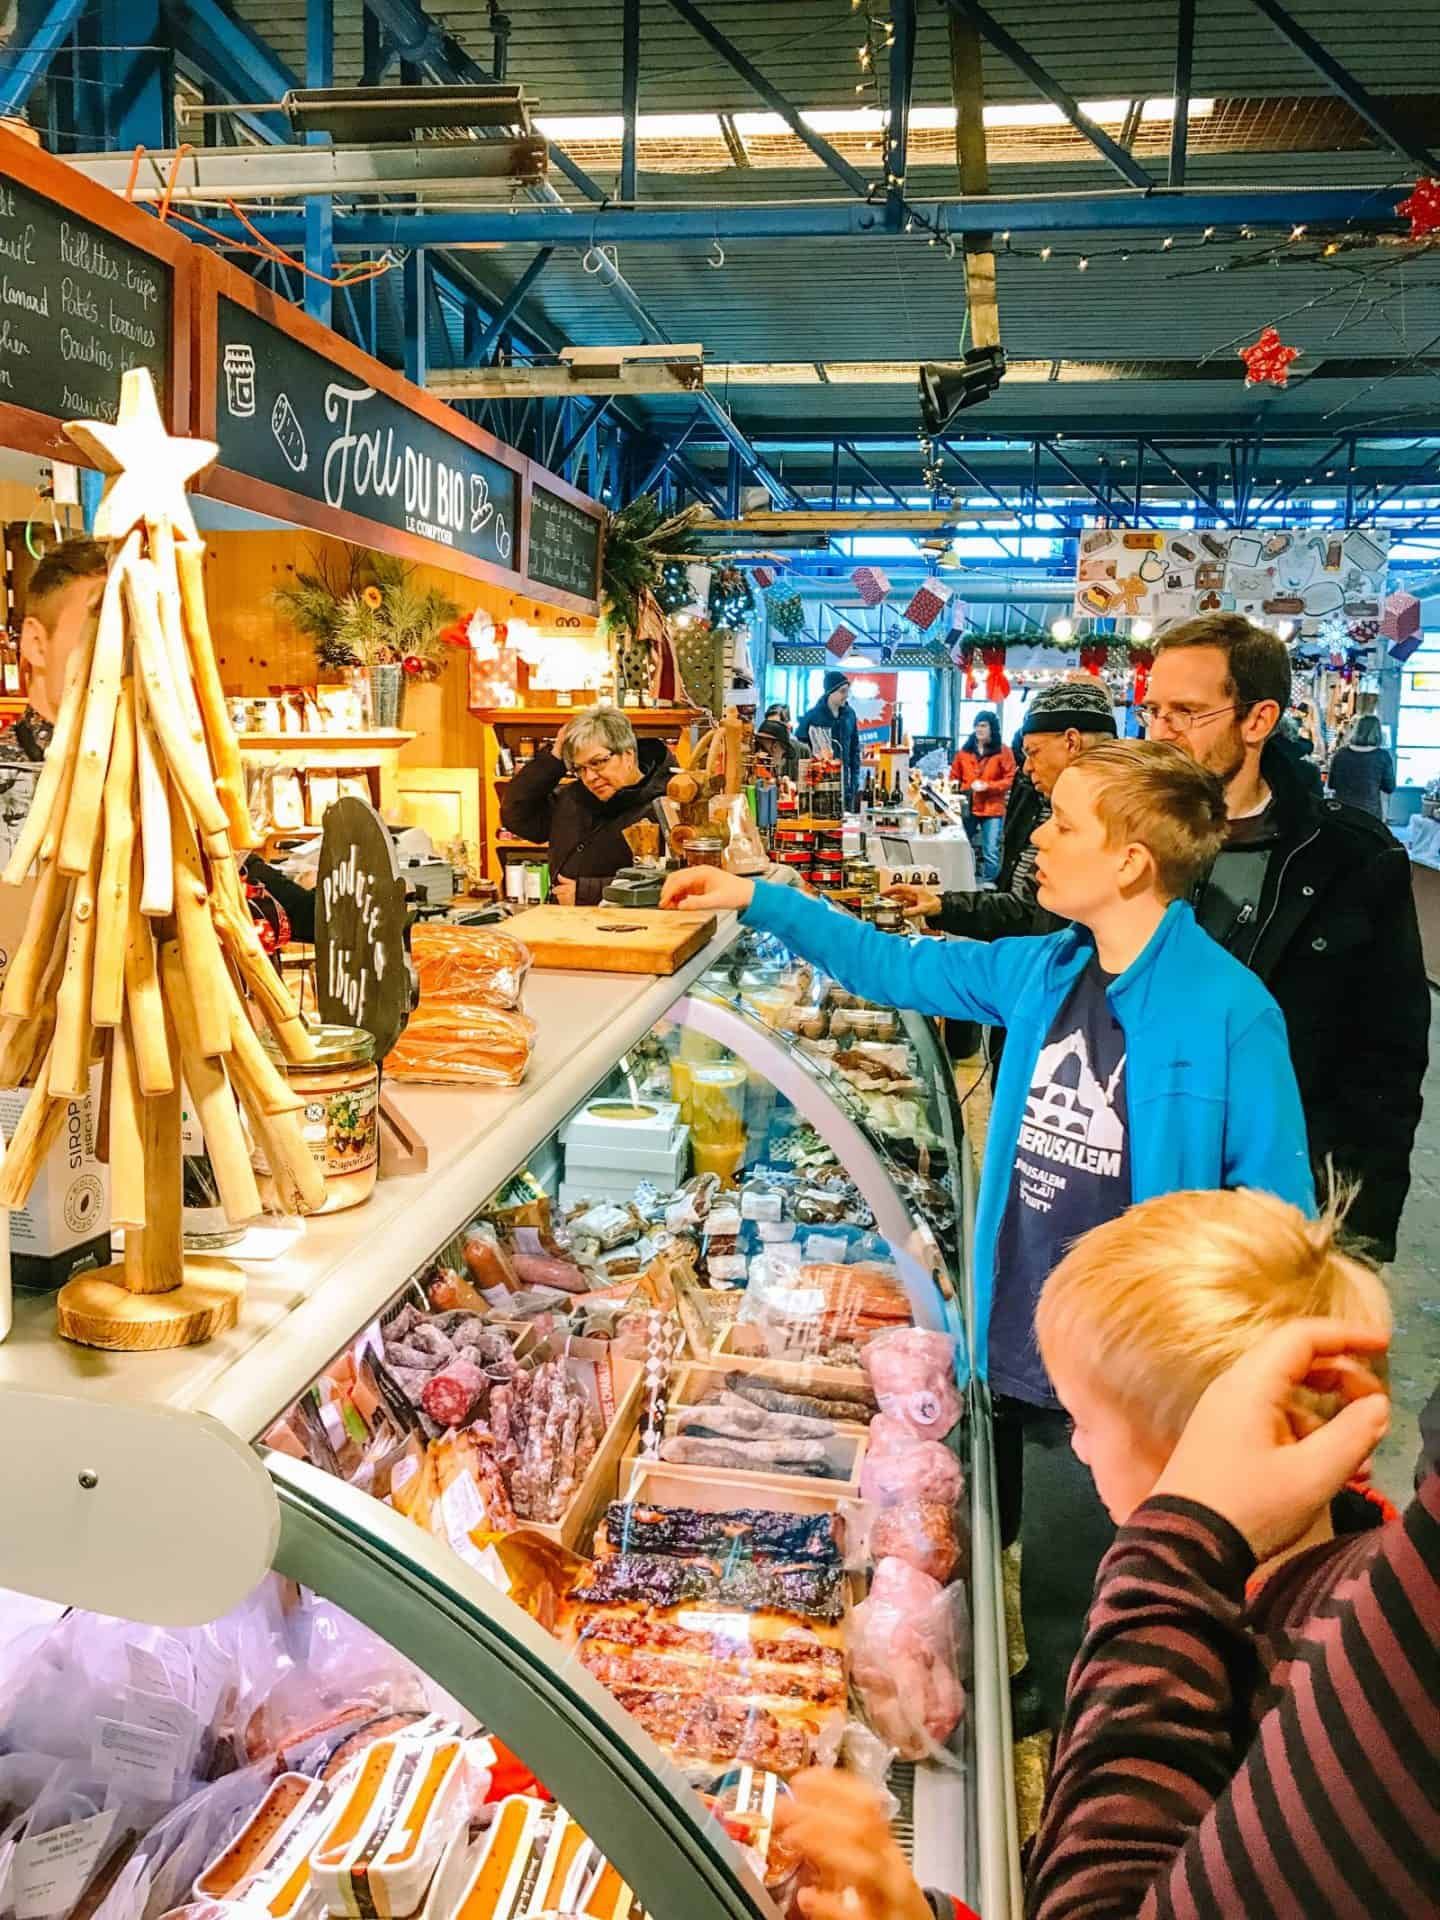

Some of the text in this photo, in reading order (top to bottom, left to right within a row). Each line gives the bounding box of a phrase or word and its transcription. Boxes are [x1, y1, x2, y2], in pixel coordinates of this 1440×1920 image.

[405, 446, 431, 518] DU
[437, 462, 464, 532] BIO
[406, 515, 416, 533] LE
[68, 1102, 82, 1169] SIROP
[84, 1113, 94, 1156] BIRCH
